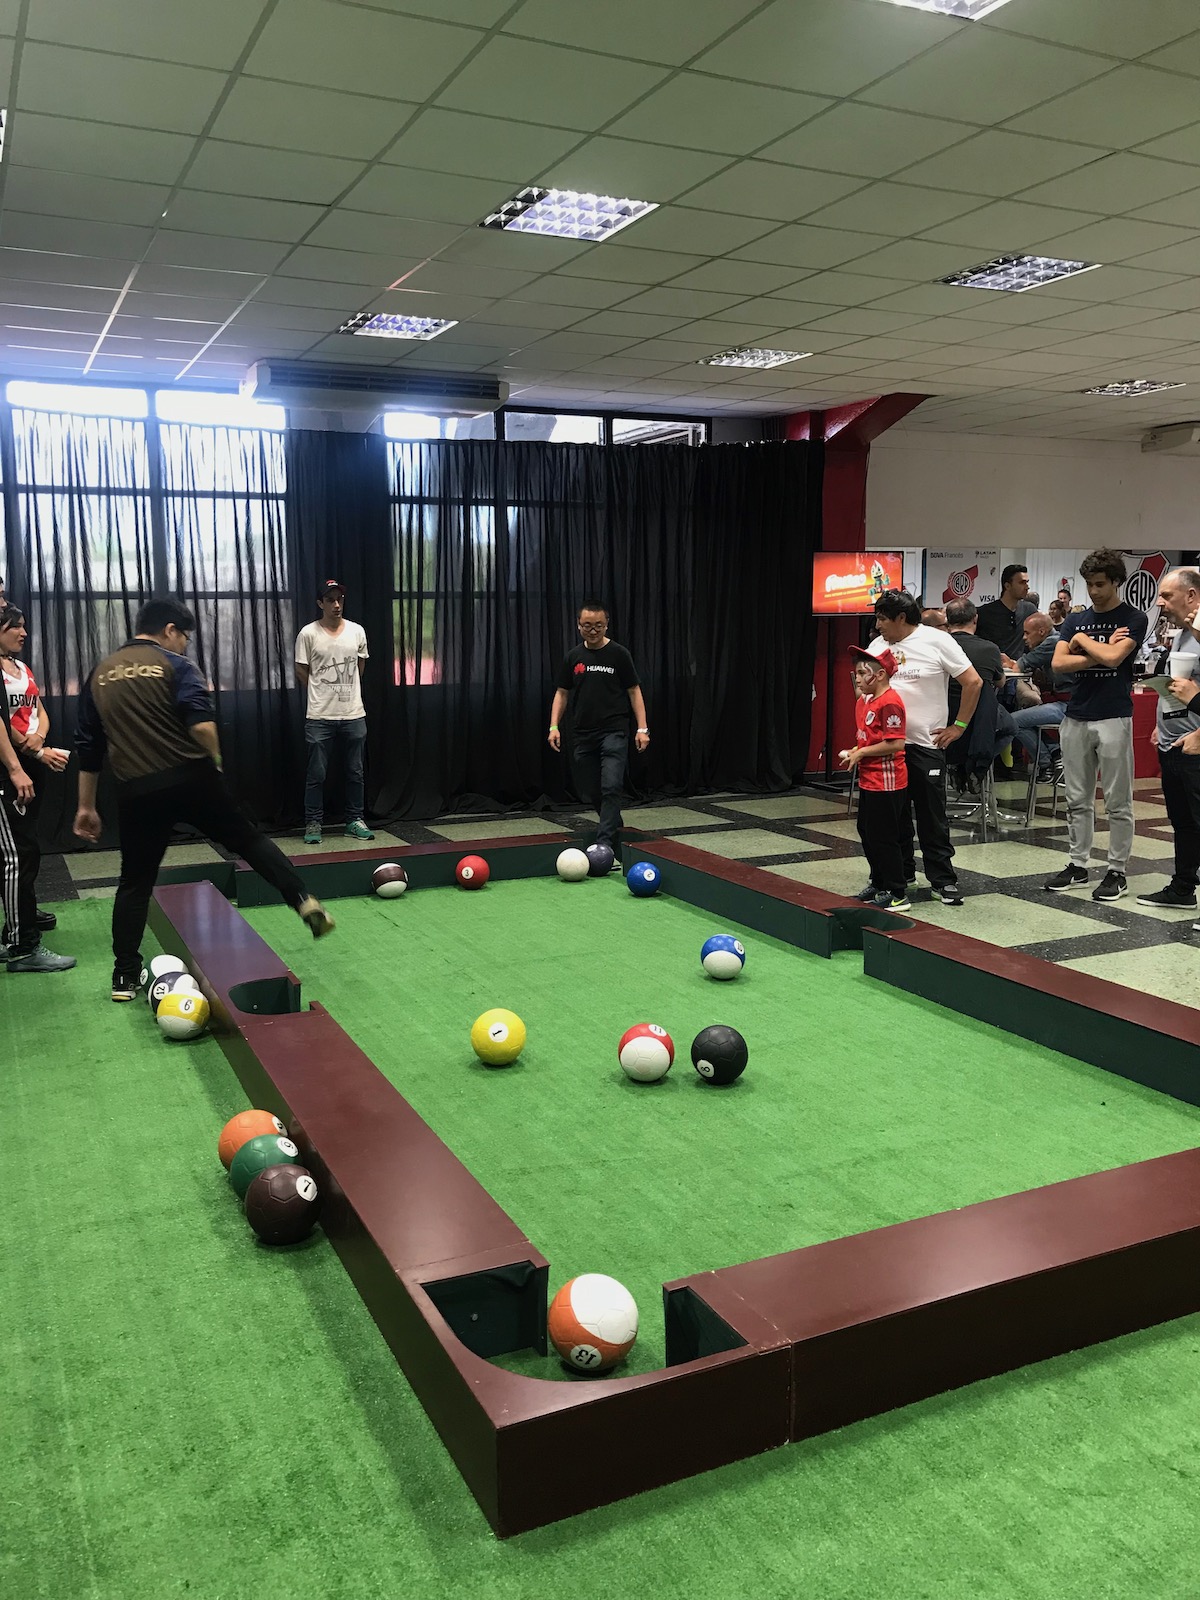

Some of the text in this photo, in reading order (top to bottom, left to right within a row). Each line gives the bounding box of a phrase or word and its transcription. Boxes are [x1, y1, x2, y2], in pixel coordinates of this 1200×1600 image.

[108, 662, 164, 681] adidas
[586, 665, 615, 675] HUAWEI
[9, 694, 38, 709] BBVA
[464, 869, 470, 878] 3
[155, 985, 166, 996] 12
[491, 1029, 503, 1037] 1
[303, 1178, 312, 1193] 7
[575, 1349, 597, 1365] 13
